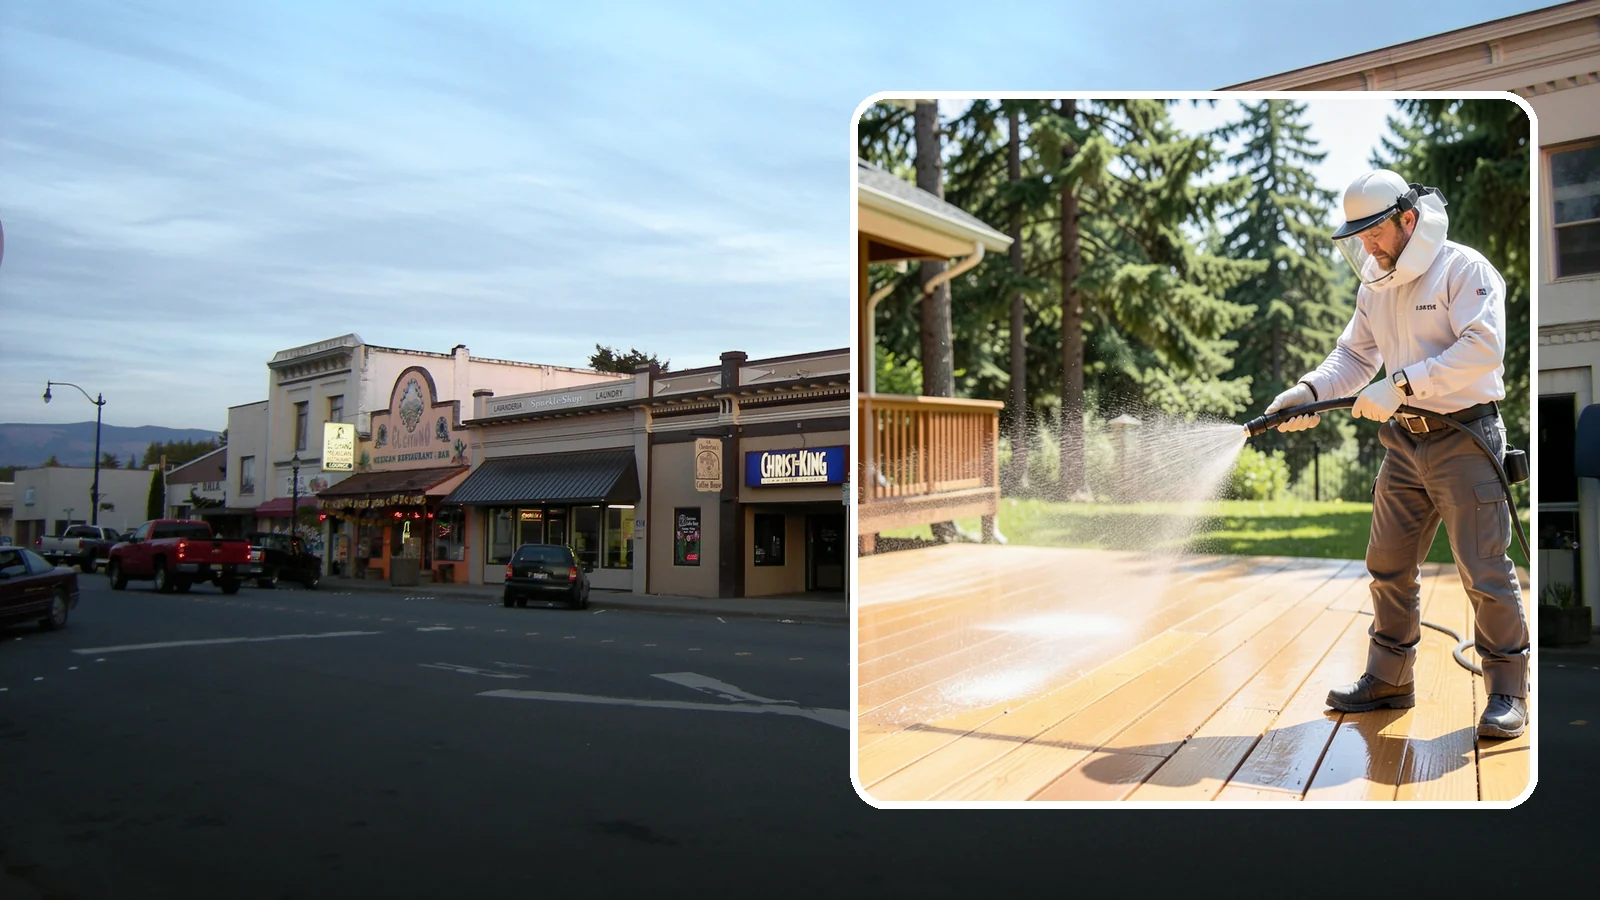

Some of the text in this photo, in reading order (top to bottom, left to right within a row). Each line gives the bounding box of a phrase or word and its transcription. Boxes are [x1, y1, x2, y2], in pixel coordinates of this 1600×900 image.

[595, 388, 624, 400] LAUNDRY
[493, 402, 523, 413] LAVANDERIA
[531, 394, 582, 409] Sparkle Shop
[373, 455, 396, 464] MEXICAN
[397, 451, 433, 462] RESTAURANT
[438, 449, 450, 458] BAR
[697, 480, 722, 489] Coffee House
